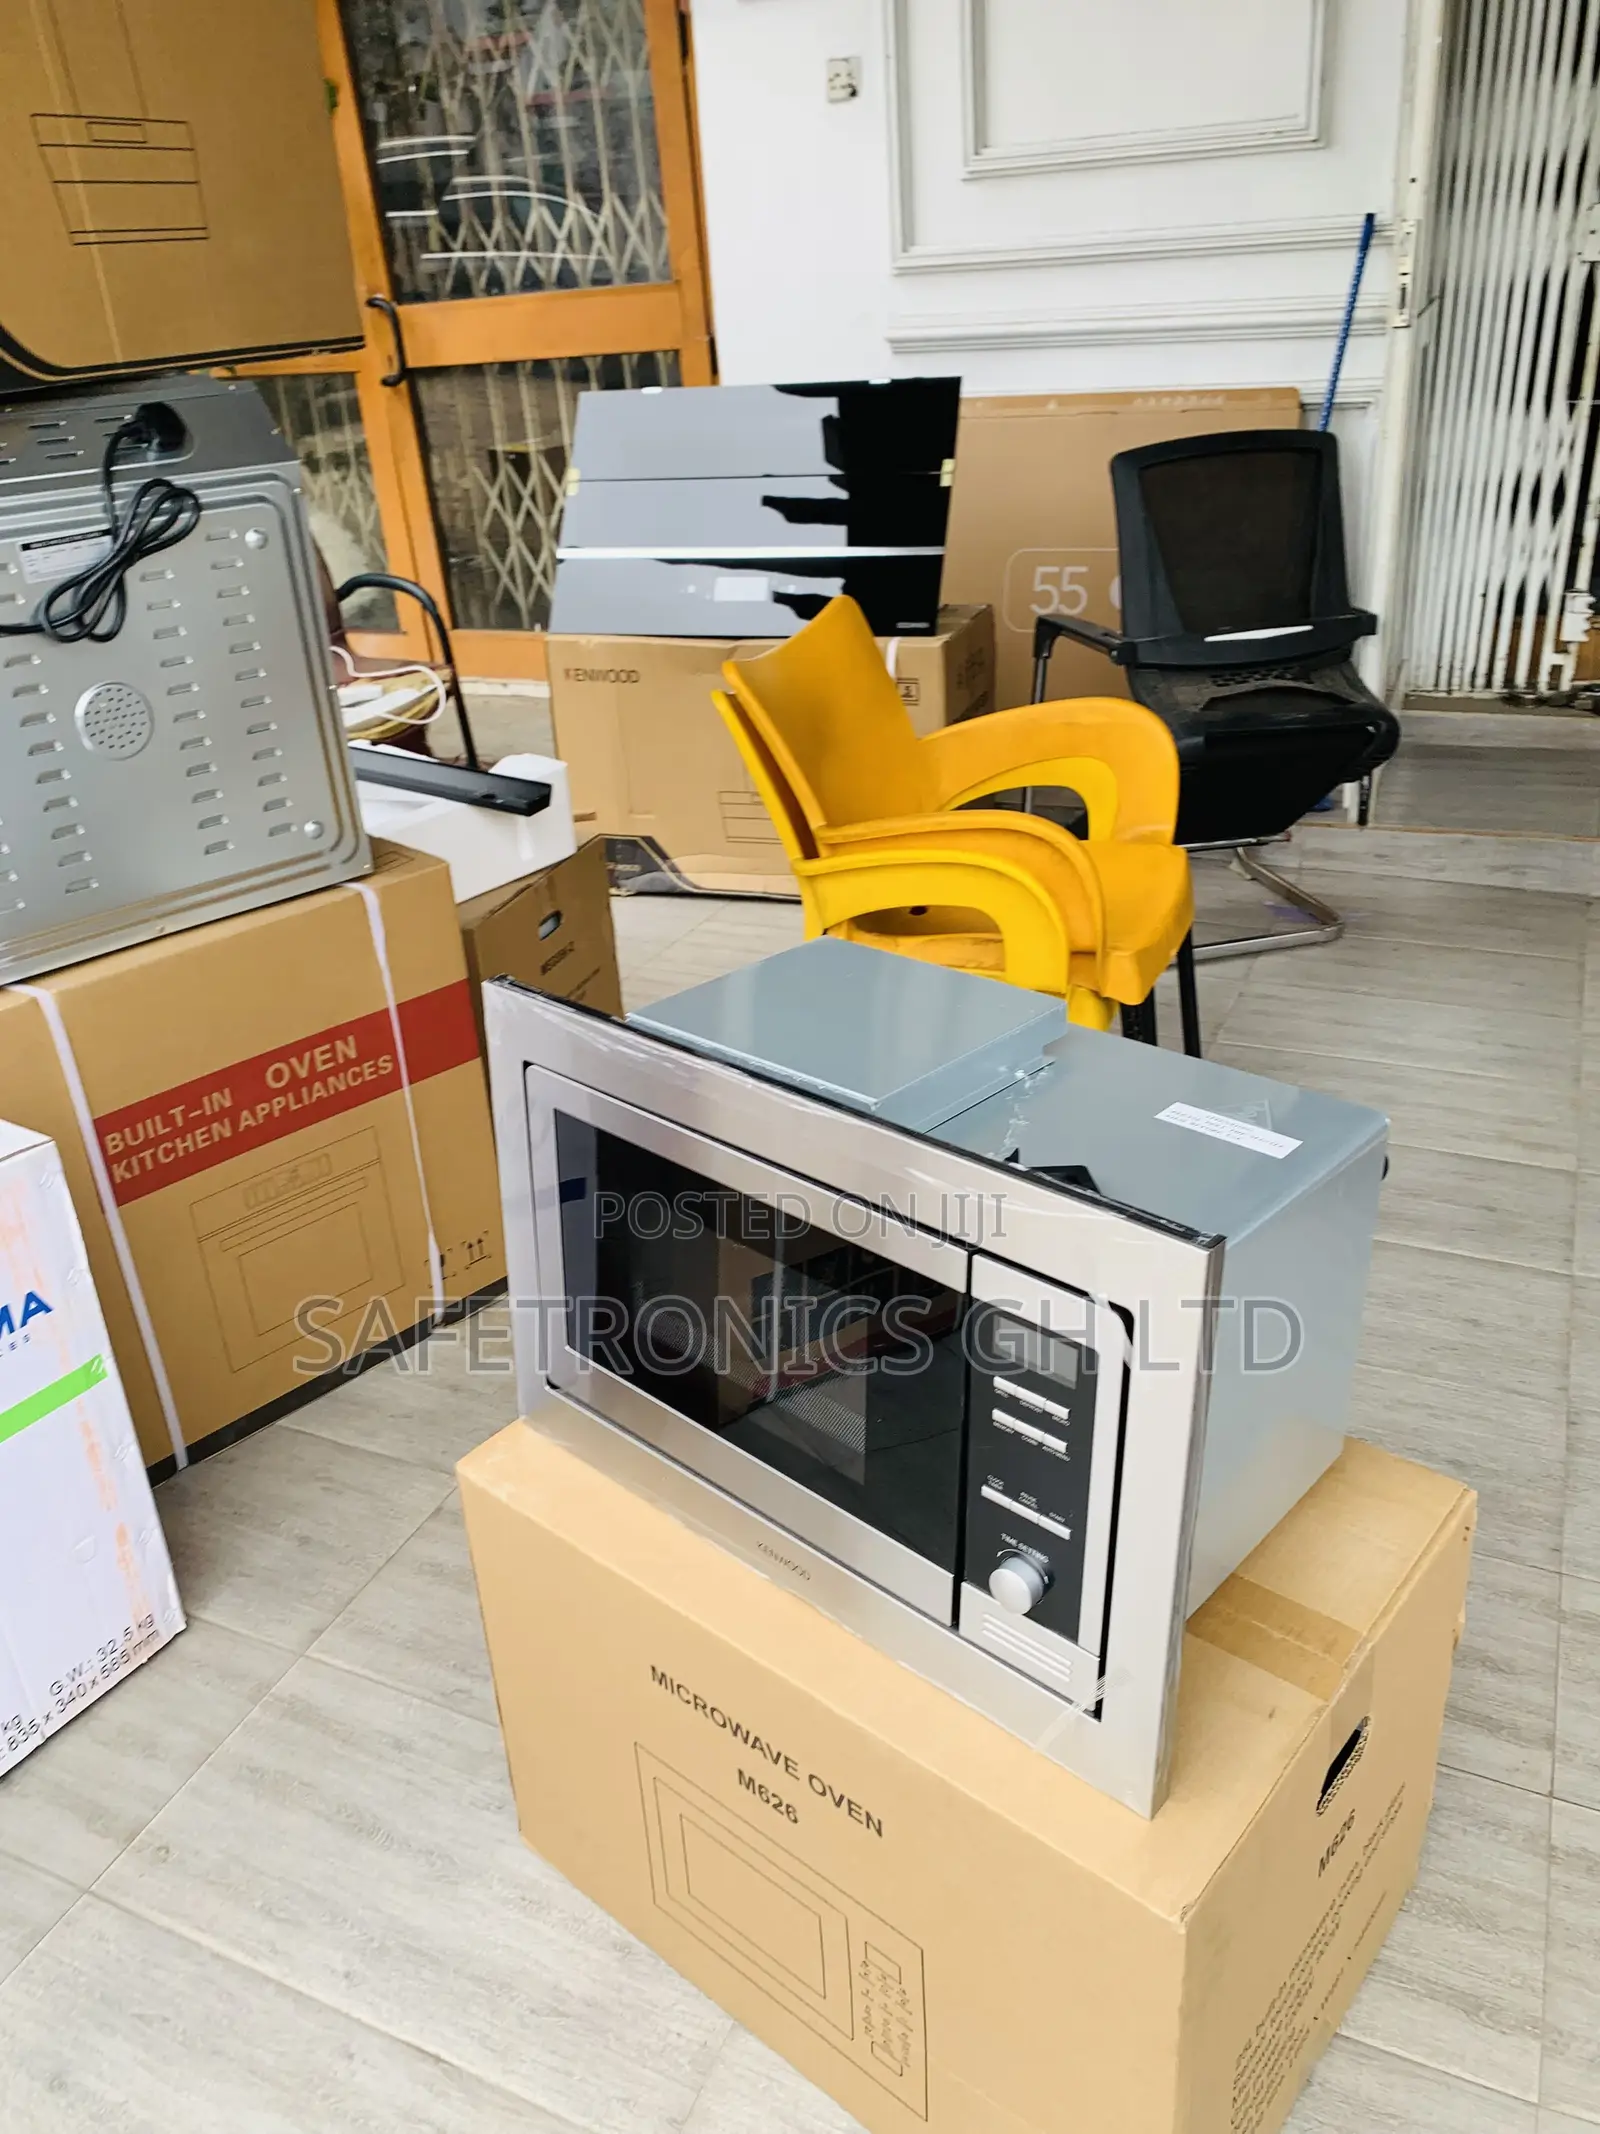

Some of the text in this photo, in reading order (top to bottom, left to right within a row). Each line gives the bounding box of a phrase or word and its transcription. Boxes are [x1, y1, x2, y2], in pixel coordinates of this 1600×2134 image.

[1029, 565, 1089, 616] 55
[563, 668, 641, 683] KENWOOD
[104, 1035, 358, 1155] BUILT-IN OVEN
[112, 1054, 394, 1184] KITCHEN APPLIANCES
[136, 1613, 155, 1632] kg
[7, 1718, 41, 1752] 835
[55, 1681, 88, 1714] 340
[100, 1648, 131, 1680] 585
[650, 1664, 884, 1839] MICROWAVE OVEN
[738, 1768, 799, 1825] M626
[1318, 1807, 1356, 1878] M626
